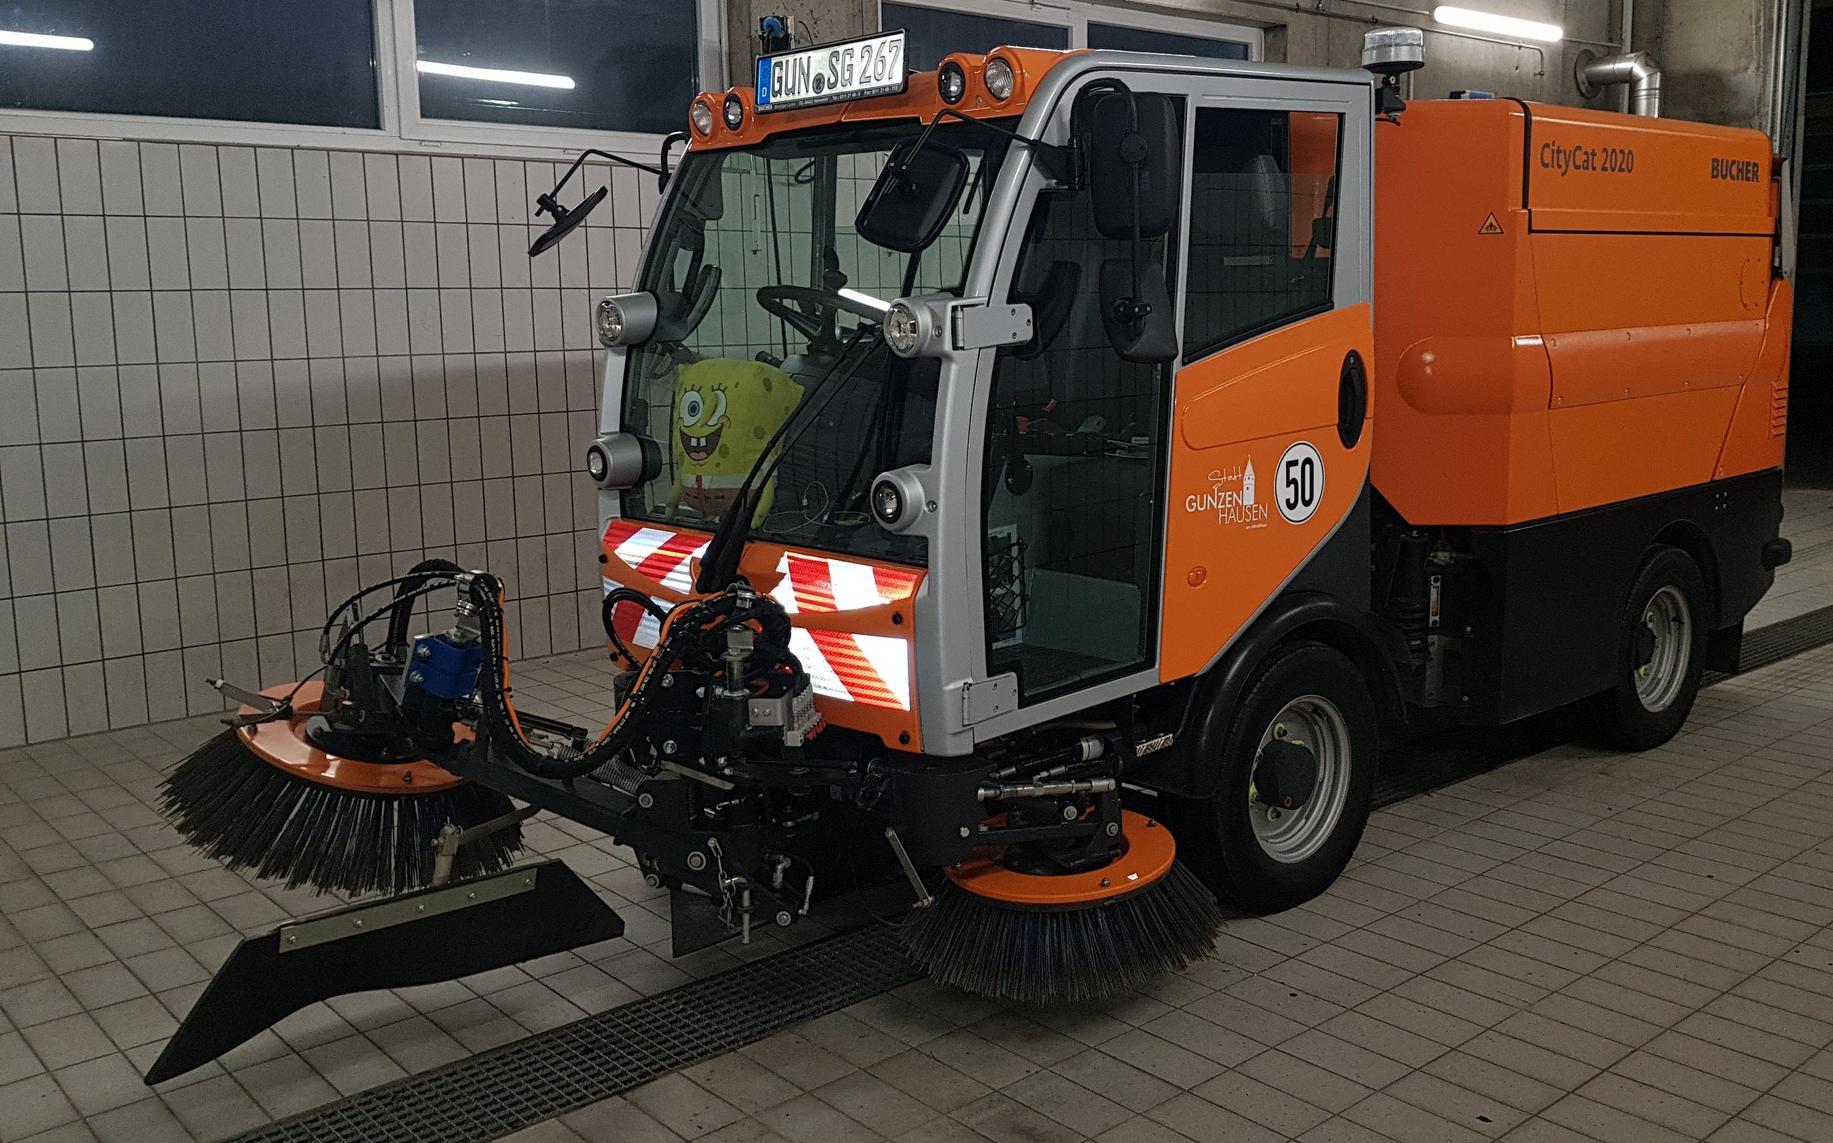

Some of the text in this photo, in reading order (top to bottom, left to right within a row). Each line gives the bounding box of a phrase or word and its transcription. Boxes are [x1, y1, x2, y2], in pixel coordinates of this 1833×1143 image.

[772, 39, 902, 98] GUN SG 267
[761, 87, 768, 97] D
[1540, 140, 1634, 177] CityCat 2020
[1711, 157, 1760, 182] BUCHER
[1208, 466, 1242, 489] Stadt
[1285, 457, 1315, 511] 50
[1185, 490, 1242, 512] GUNZEN
[1218, 504, 1268, 525] HAUSEN
